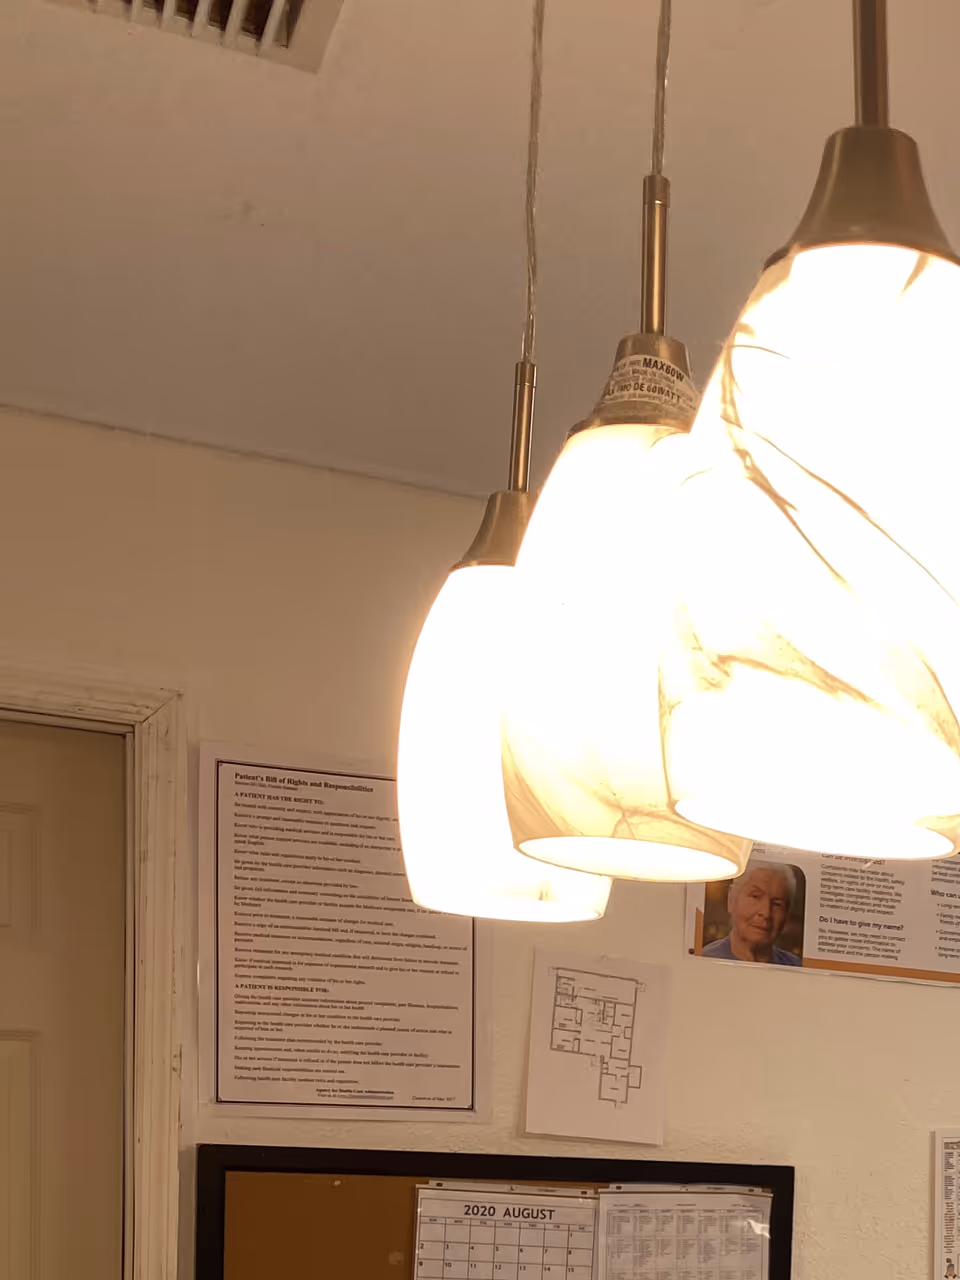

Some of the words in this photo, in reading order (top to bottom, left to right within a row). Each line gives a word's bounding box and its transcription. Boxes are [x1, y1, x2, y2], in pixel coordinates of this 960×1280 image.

[234, 772, 264, 782] Patient's
[265, 775, 277, 783] Bill
[287, 778, 308, 786] Rights
[323, 781, 374, 793] Responsibilities
[930, 889, 945, 897] Who
[819, 915, 829, 923] Do
[833, 917, 848, 925] have
[858, 921, 871, 929] give
[872, 923, 882, 931] my
[463, 1204, 496, 1217] 2020
[502, 1207, 556, 1221] AUGUST
